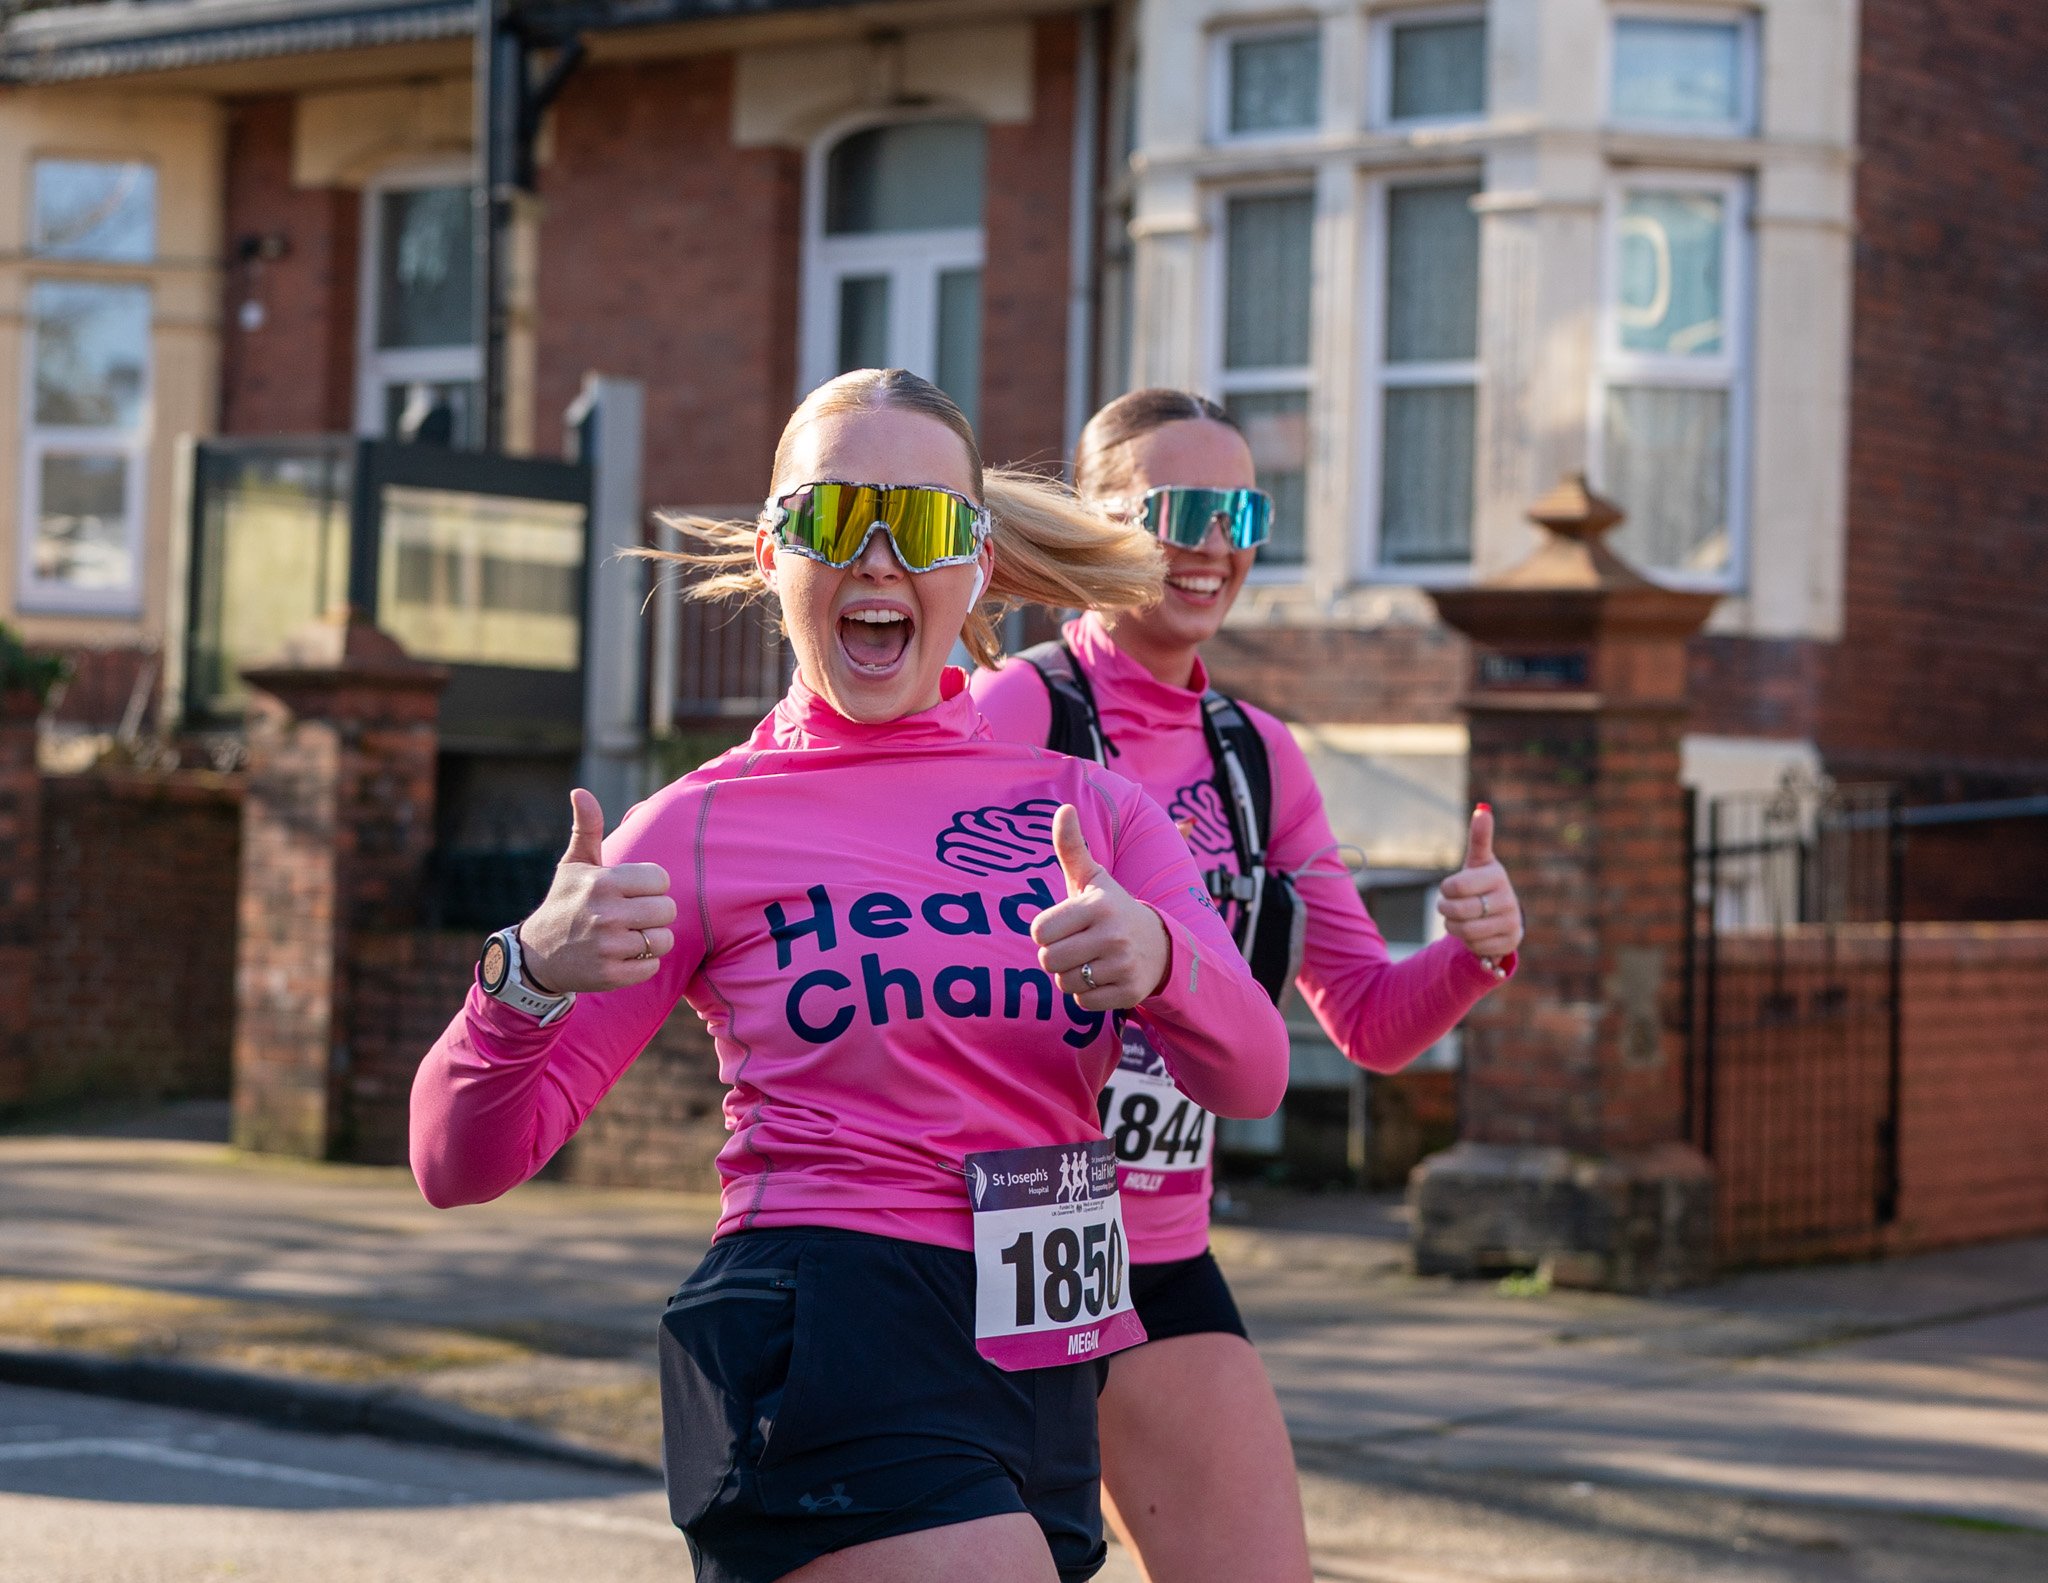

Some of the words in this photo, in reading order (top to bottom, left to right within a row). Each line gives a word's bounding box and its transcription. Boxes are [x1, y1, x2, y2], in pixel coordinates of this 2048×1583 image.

[763, 878, 1057, 970] Head
[786, 953, 1122, 1049] Chang
[992, 1173, 1005, 1186] St
[1007, 1168, 1049, 1187] Joseph's
[1091, 1163, 1107, 1181] Half
[1123, 1172, 1166, 1193] HOLLY
[1028, 1185, 1050, 1196] Hospital
[1001, 1218, 1123, 1327] 1850
[1068, 1328, 1100, 1356] MEGAN
